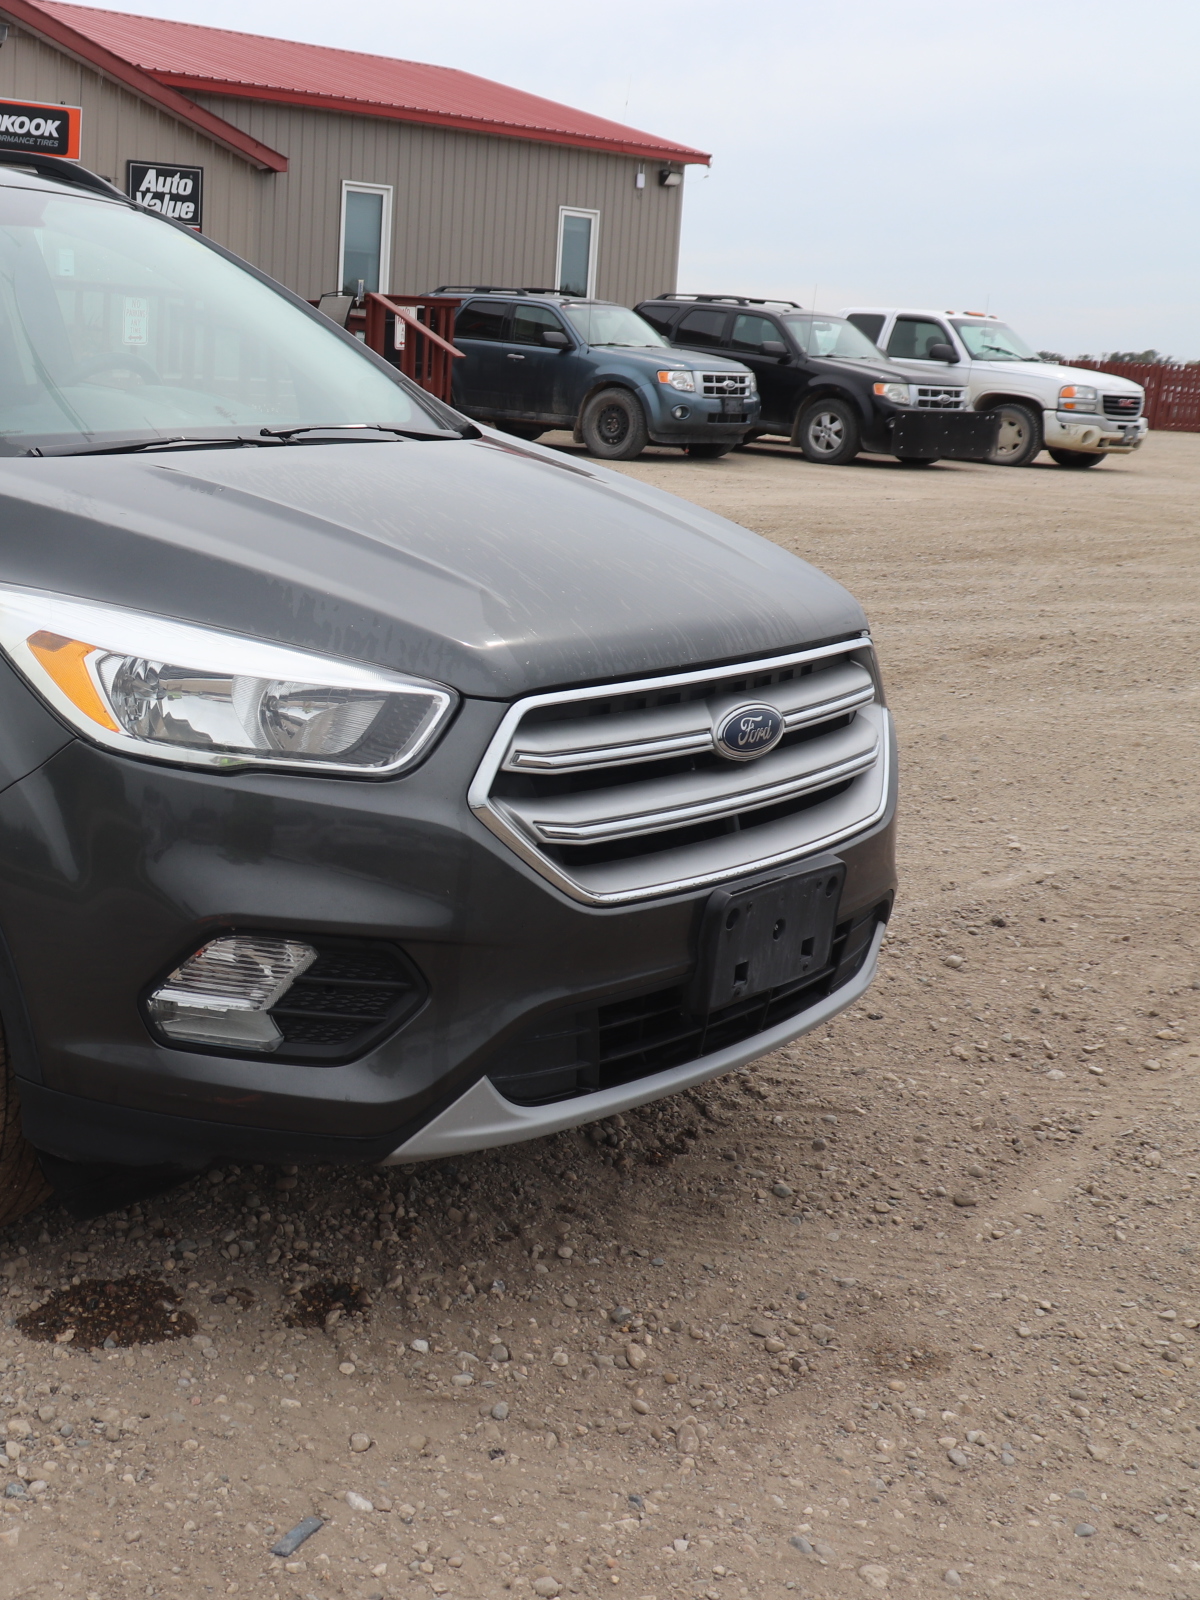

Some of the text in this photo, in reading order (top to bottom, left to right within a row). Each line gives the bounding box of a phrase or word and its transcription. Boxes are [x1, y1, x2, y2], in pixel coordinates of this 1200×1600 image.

[36, 138, 59, 147] TIRES
[139, 168, 193, 196] Auto
[136, 191, 195, 219] Value
[126, 309, 146, 317] PARKING
[132, 300, 141, 308] NO
[738, 715, 773, 746] Ford
